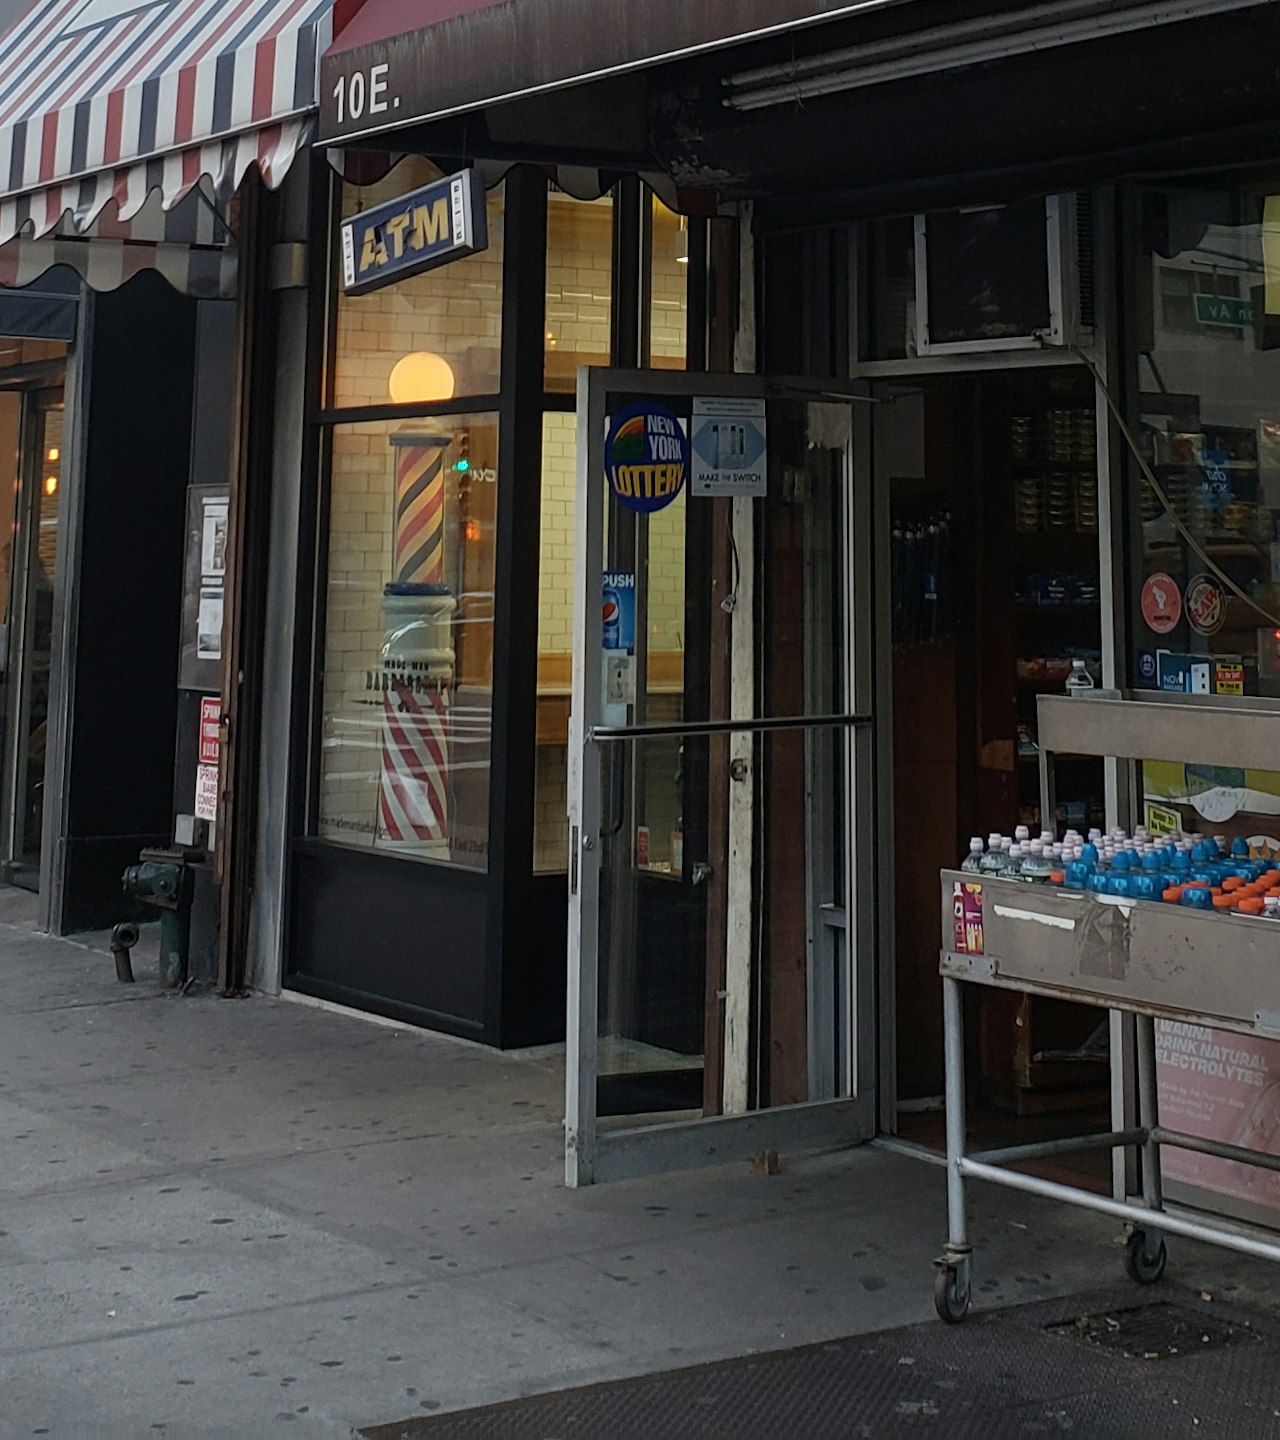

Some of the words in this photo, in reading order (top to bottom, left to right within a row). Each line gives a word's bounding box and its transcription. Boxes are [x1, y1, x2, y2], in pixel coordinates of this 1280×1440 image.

[359, 197, 449, 273] ATM
[647, 414, 676, 436] NEW
[649, 435, 683, 460] YORK
[611, 463, 685, 498] LOTTERY
[698, 473, 720, 482] MAKE
[733, 473, 761, 482] SWITCH
[603, 574, 634, 588] PUSH
[1160, 1018, 1213, 1042] WANNA
[1155, 1033, 1198, 1055] DRINK
[1200, 1044, 1269, 1072] NATURAL
[1155, 1049, 1265, 1087] ELECTROLYTES
